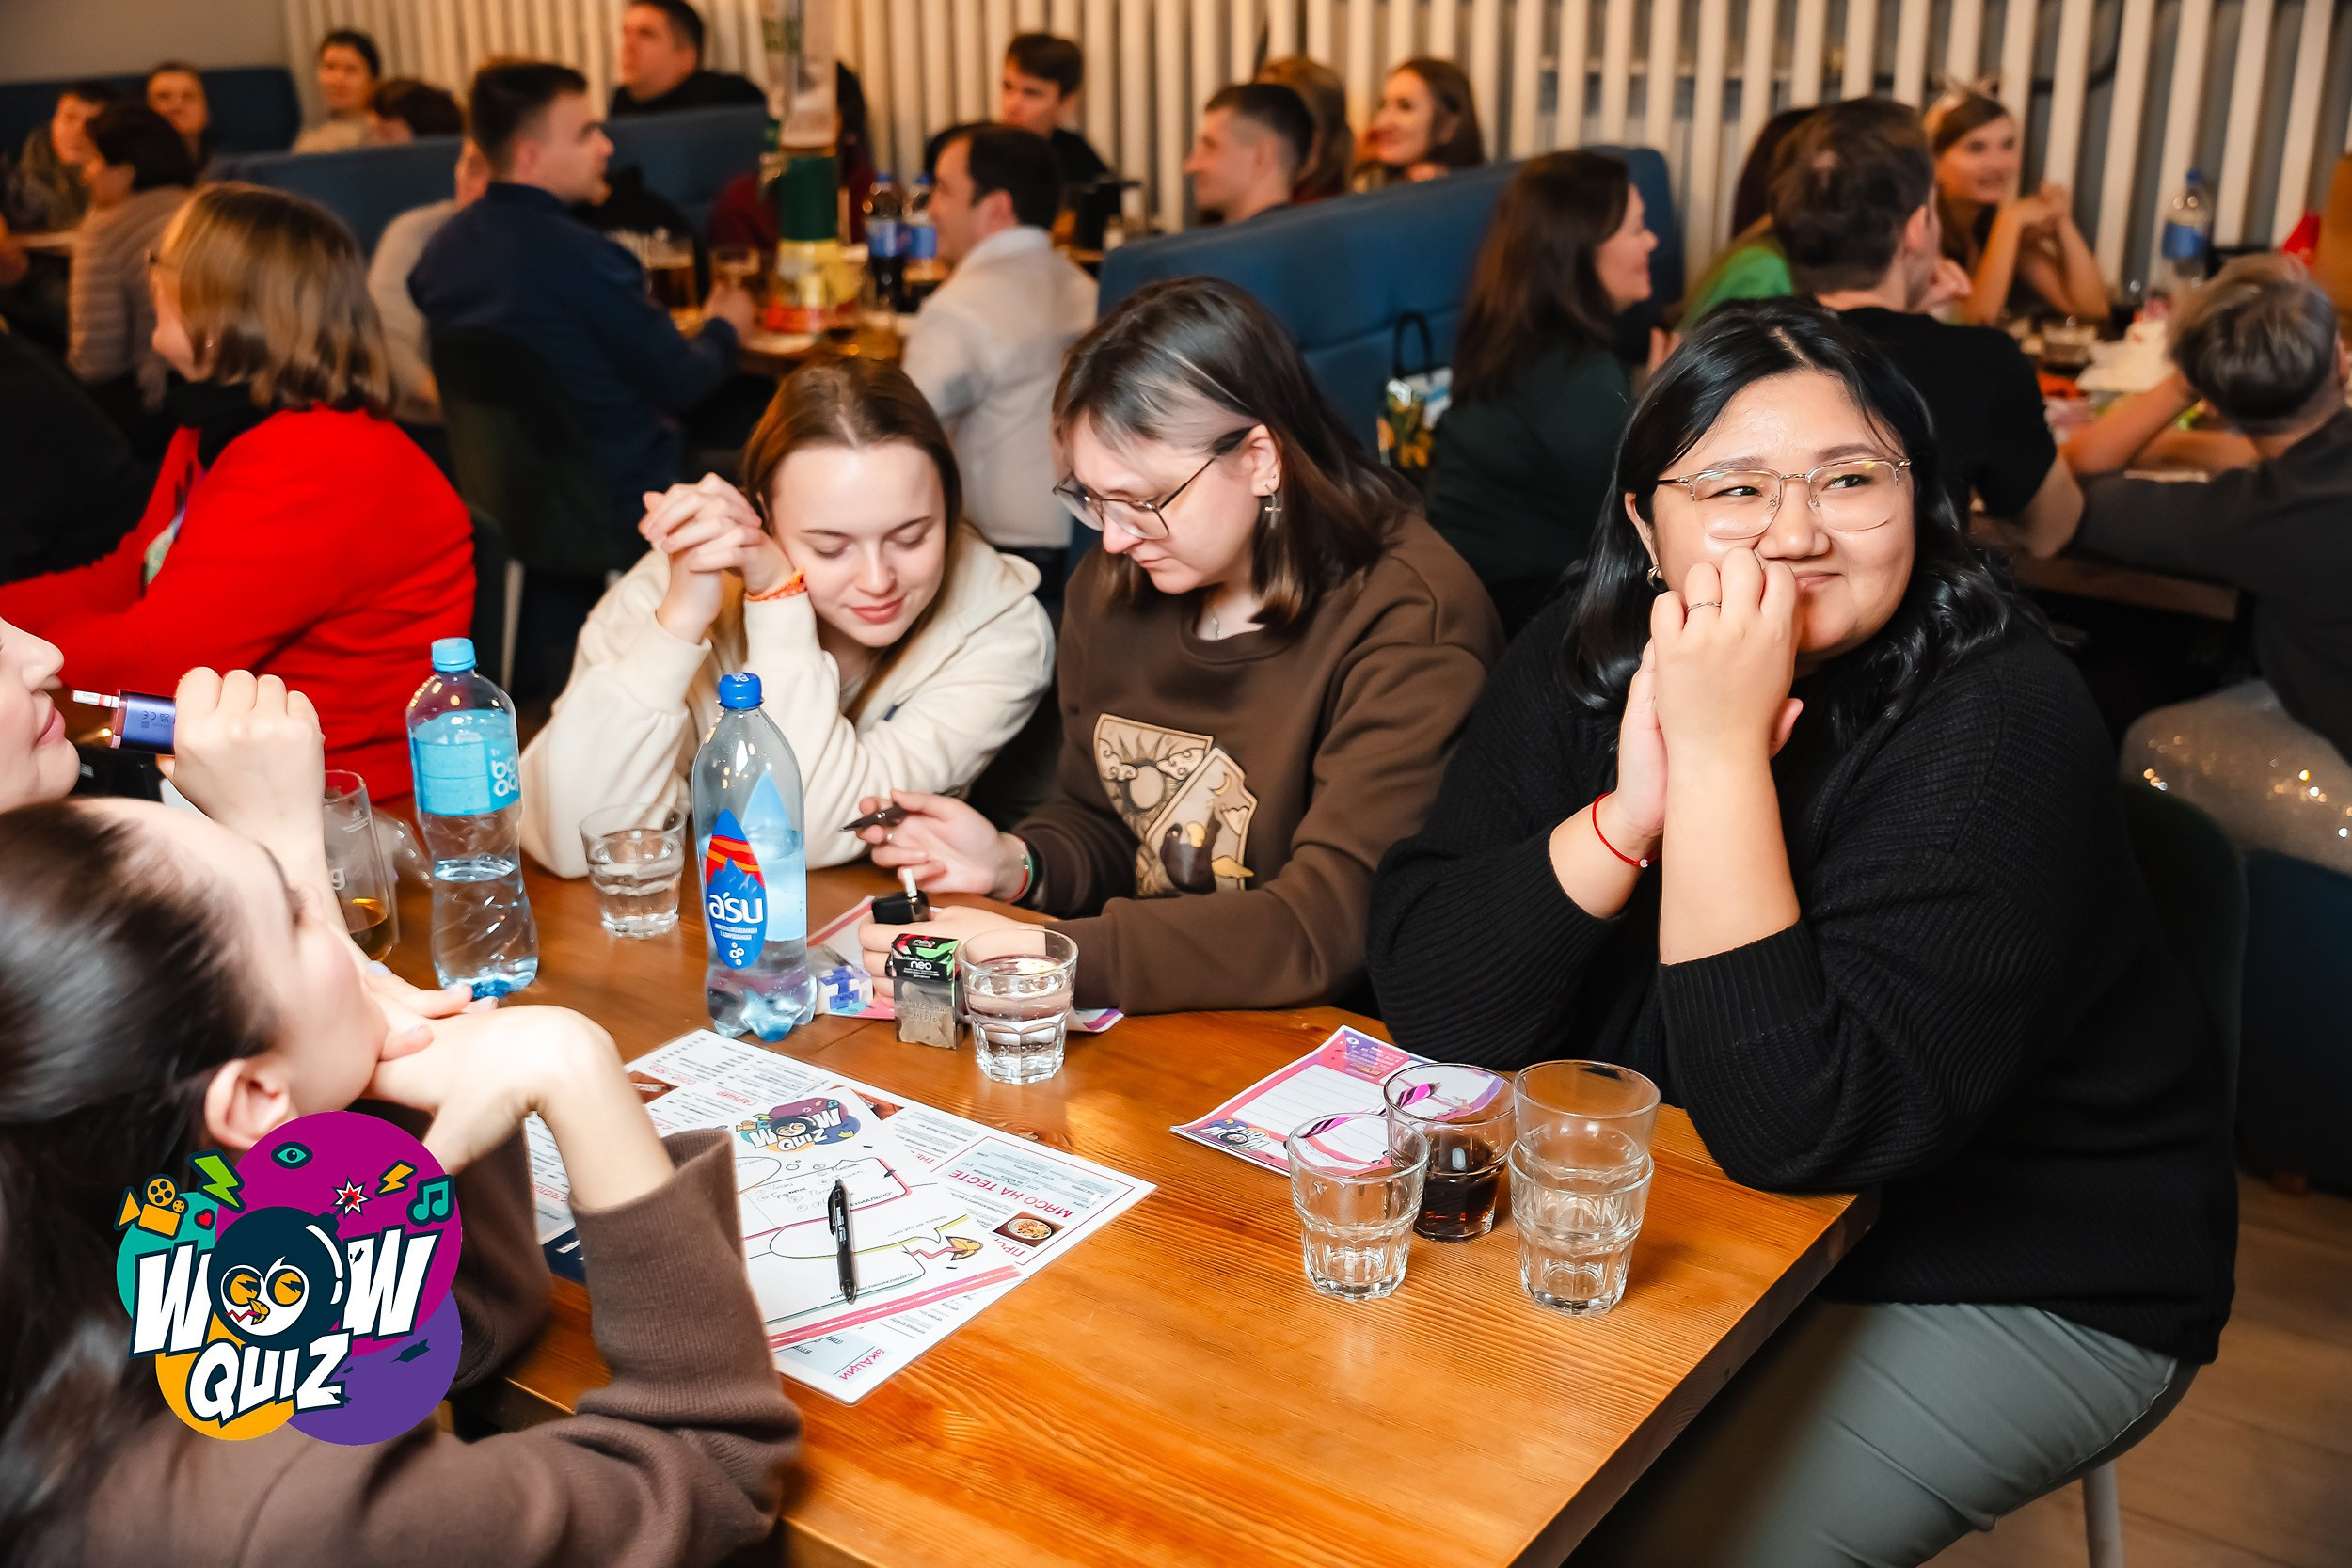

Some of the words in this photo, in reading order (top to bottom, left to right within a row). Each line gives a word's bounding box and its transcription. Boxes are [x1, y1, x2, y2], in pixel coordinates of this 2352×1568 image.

[910, 960, 931, 971] neo
[716, 1090, 758, 1107] ГАРНИР
[746, 1107, 843, 1148] WOW
[776, 1128, 829, 1153] QUIZ
[948, 1169, 999, 1193] ТЕСТЕ
[850, 1191, 892, 1207] ЕНИАЛЬНО!
[1000, 1187, 1023, 1199] НА
[1023, 1196, 1074, 1218] МЯСО
